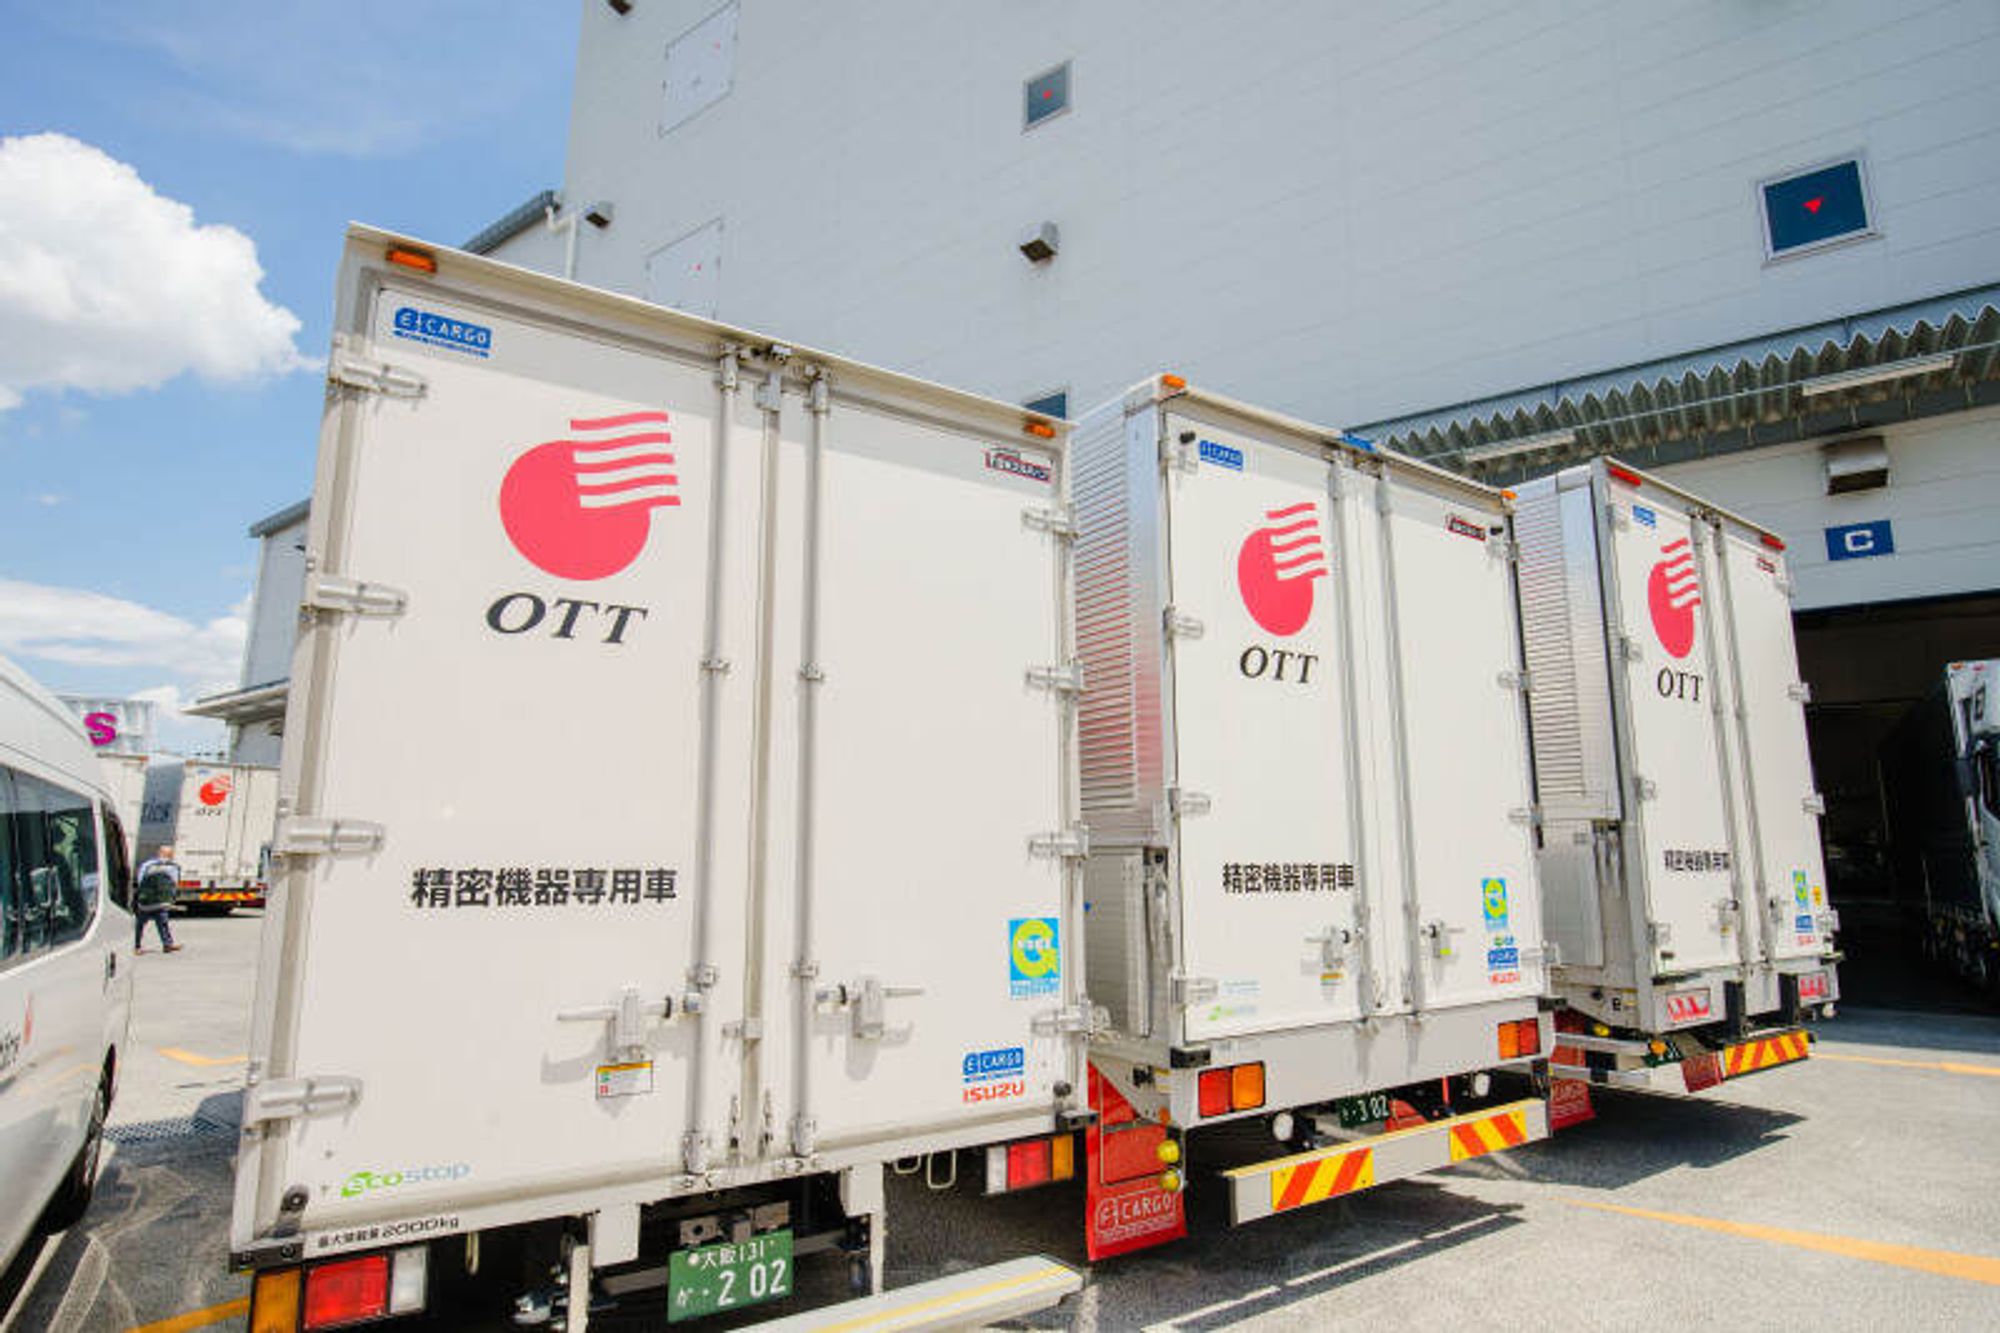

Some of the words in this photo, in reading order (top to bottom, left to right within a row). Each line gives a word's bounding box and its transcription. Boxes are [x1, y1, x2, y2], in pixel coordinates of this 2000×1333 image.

[426, 319, 487, 344] CARGO
[1845, 530, 1874, 552] C
[485, 592, 648, 644] OTT
[1240, 646, 1319, 684] OTT
[1657, 668, 1703, 702] OTT
[84, 712, 116, 746] S
[411, 867, 678, 908] 精密機器専用車
[982, 1051, 1022, 1069] CARGO
[962, 1080, 1025, 1104] ISUZU
[1122, 1193, 1171, 1219] CARGO
[717, 1258, 787, 1306] 202
